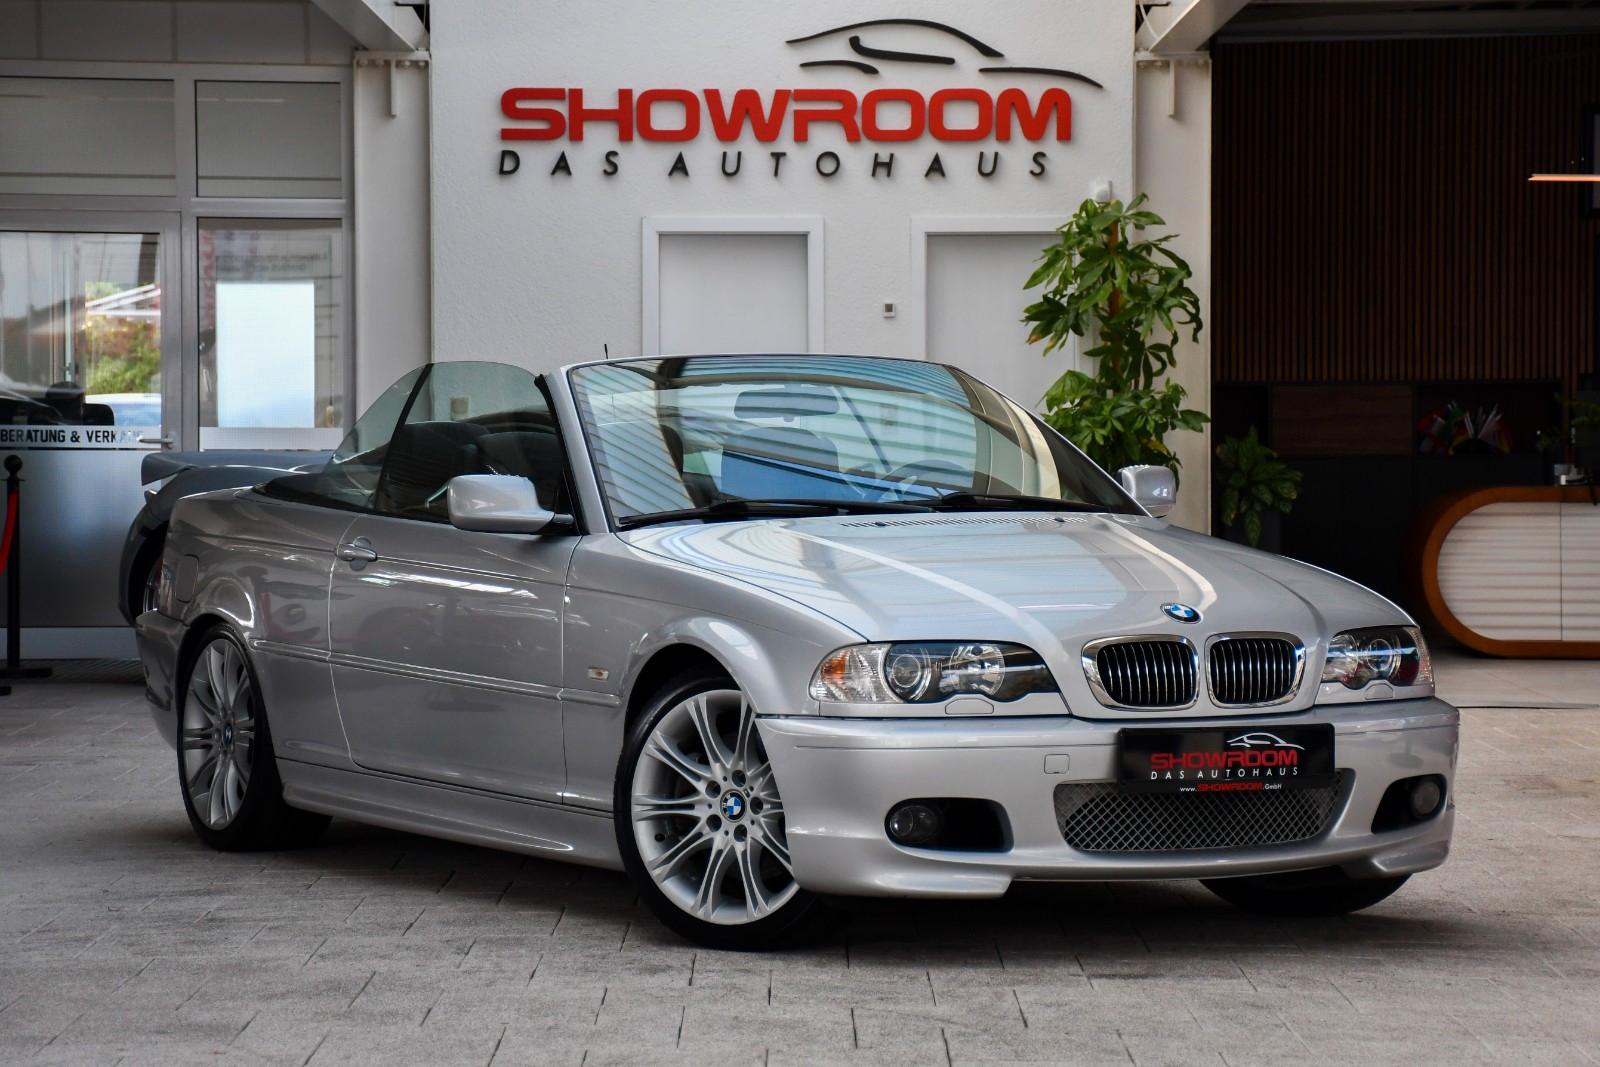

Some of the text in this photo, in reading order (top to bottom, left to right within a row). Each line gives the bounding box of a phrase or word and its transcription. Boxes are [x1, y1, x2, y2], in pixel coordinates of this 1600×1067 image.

[499, 87, 1073, 142] SHOWROOM
[499, 150, 1047, 178] DAS AUTOHAUS
[0, 429, 144, 443] BERATUNG & VERK
[1150, 750, 1299, 769] SHOWROOM
[1150, 766, 1299, 780] DAS AUTOHAUS
